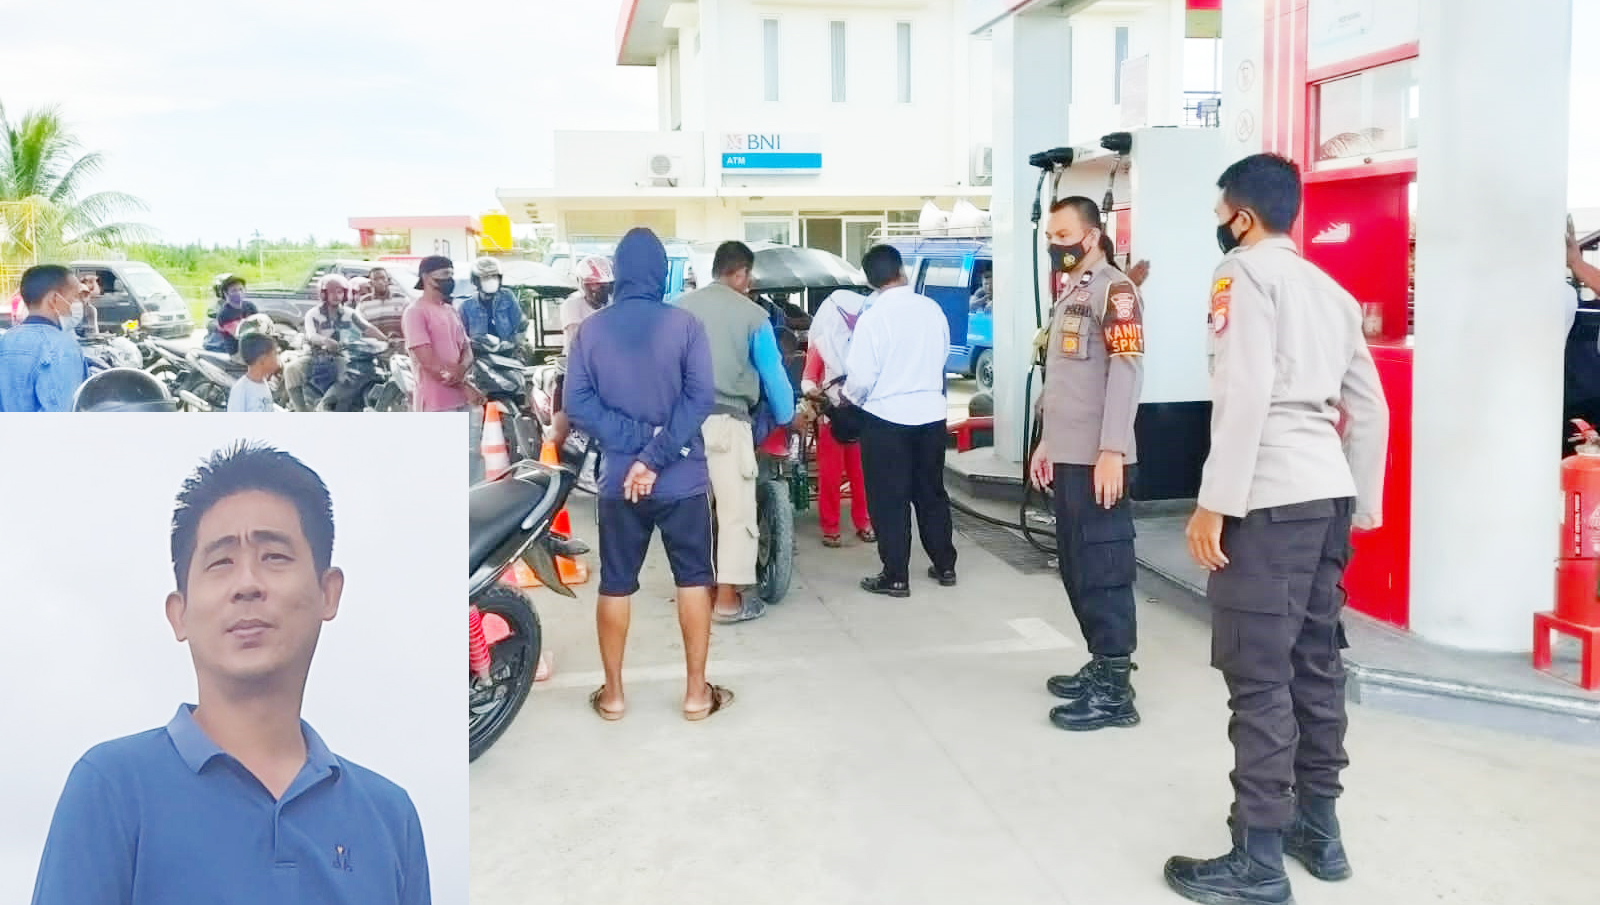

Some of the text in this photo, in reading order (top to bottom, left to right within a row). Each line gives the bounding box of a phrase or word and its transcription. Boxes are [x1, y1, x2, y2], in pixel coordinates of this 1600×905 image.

[748, 134, 780, 149] BNI
[727, 157, 746, 165] ATM
[1104, 325, 1142, 341] KANIT
